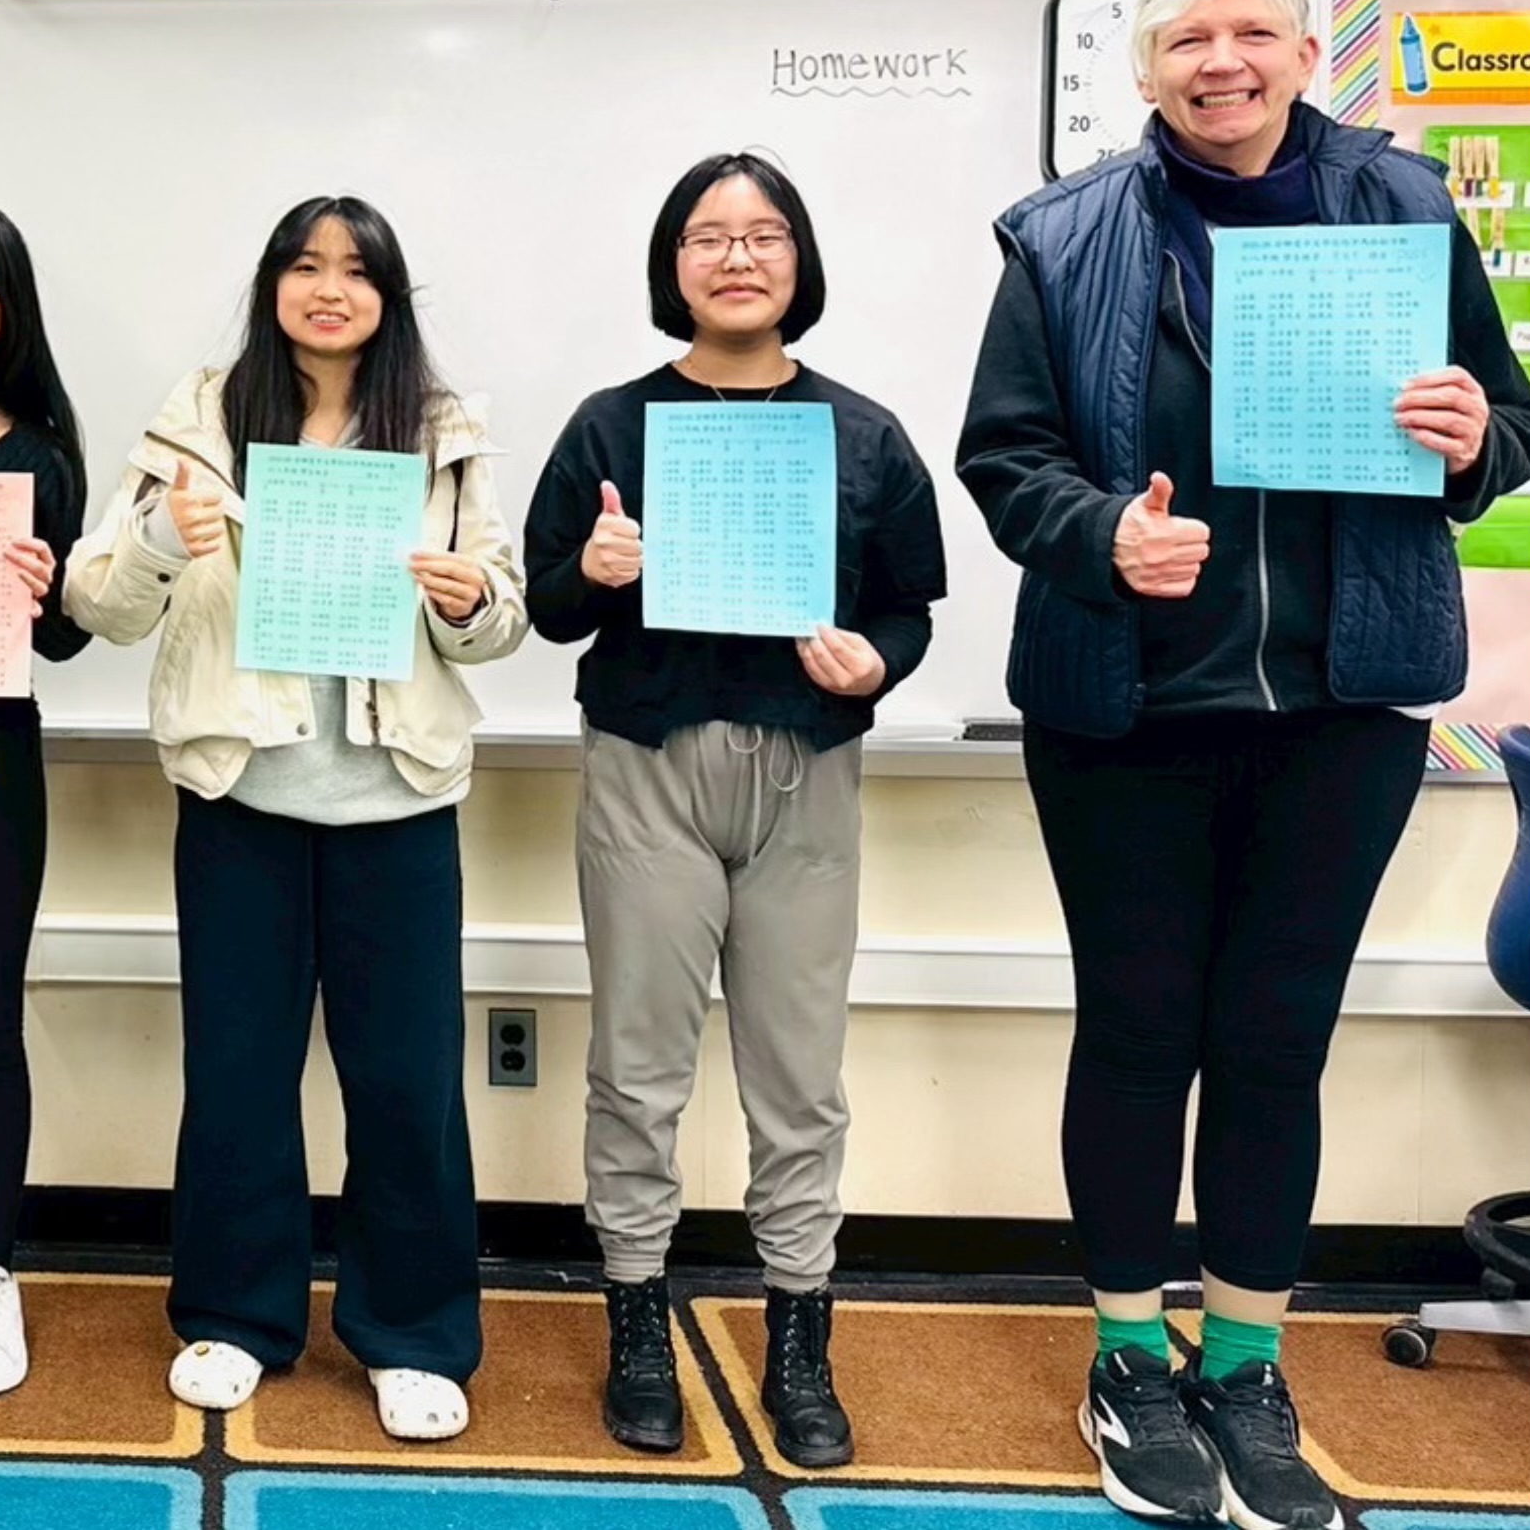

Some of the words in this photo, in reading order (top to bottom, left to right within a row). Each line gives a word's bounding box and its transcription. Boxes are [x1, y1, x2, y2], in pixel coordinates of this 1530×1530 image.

[1111, 1, 1123, 20] 5
[1076, 32, 1094, 51] 10
[770, 47, 969, 88] Homework
[1062, 75, 1080, 93] 15
[1068, 115, 1092, 133] 20
